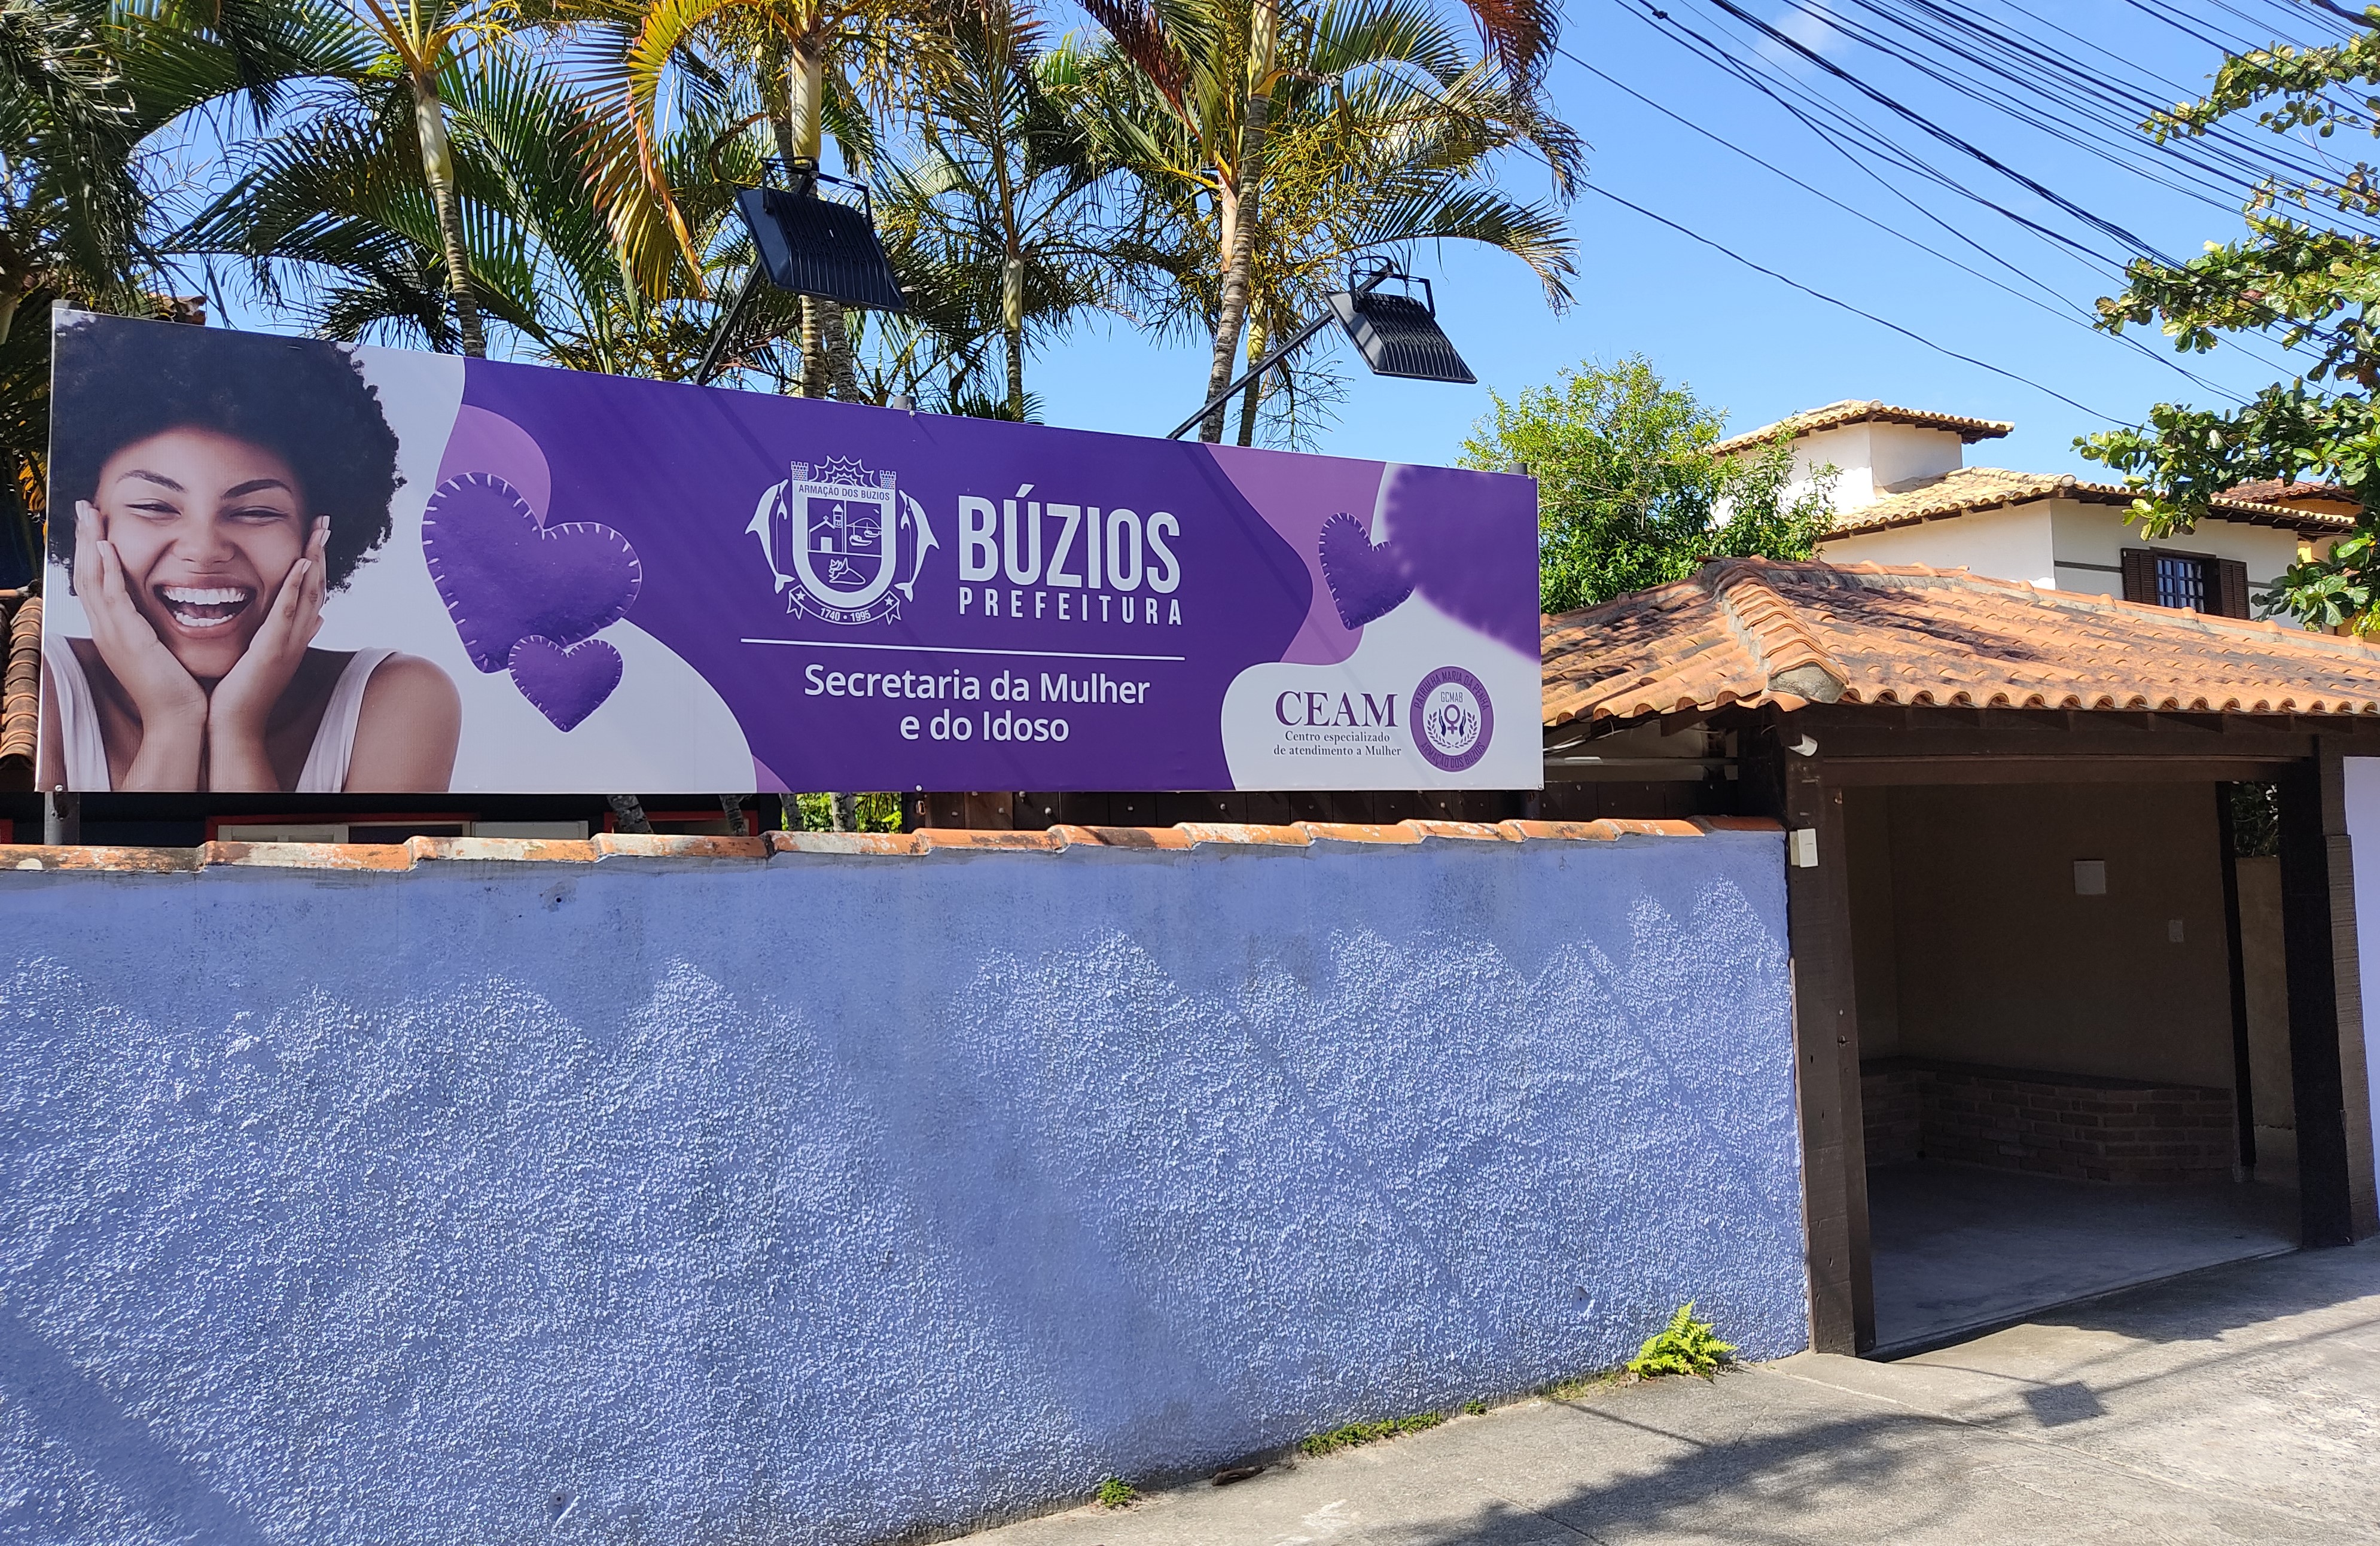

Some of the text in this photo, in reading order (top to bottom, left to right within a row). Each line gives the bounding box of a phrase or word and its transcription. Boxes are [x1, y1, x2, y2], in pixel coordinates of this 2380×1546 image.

[799, 484, 890, 501] ARMAÇÃO DOS BÚZIOS
[958, 483, 1181, 594] BÚZIOS
[820, 608, 871, 622] 1740 1995
[959, 587, 1182, 626] PREFEITURA
[804, 664, 1150, 704] Secretaria da Mulher
[1413, 670, 1490, 711] PATRULHA MARIA DA PENHA
[1275, 691, 1398, 727] CEAM
[1440, 691, 1464, 703] GCMAB
[900, 708, 1069, 742] e do Idoso
[1285, 730, 1390, 745] Centro especializado
[1273, 744, 1402, 757] de atendimento a Mulher
[1450, 757, 1464, 769] DOS
